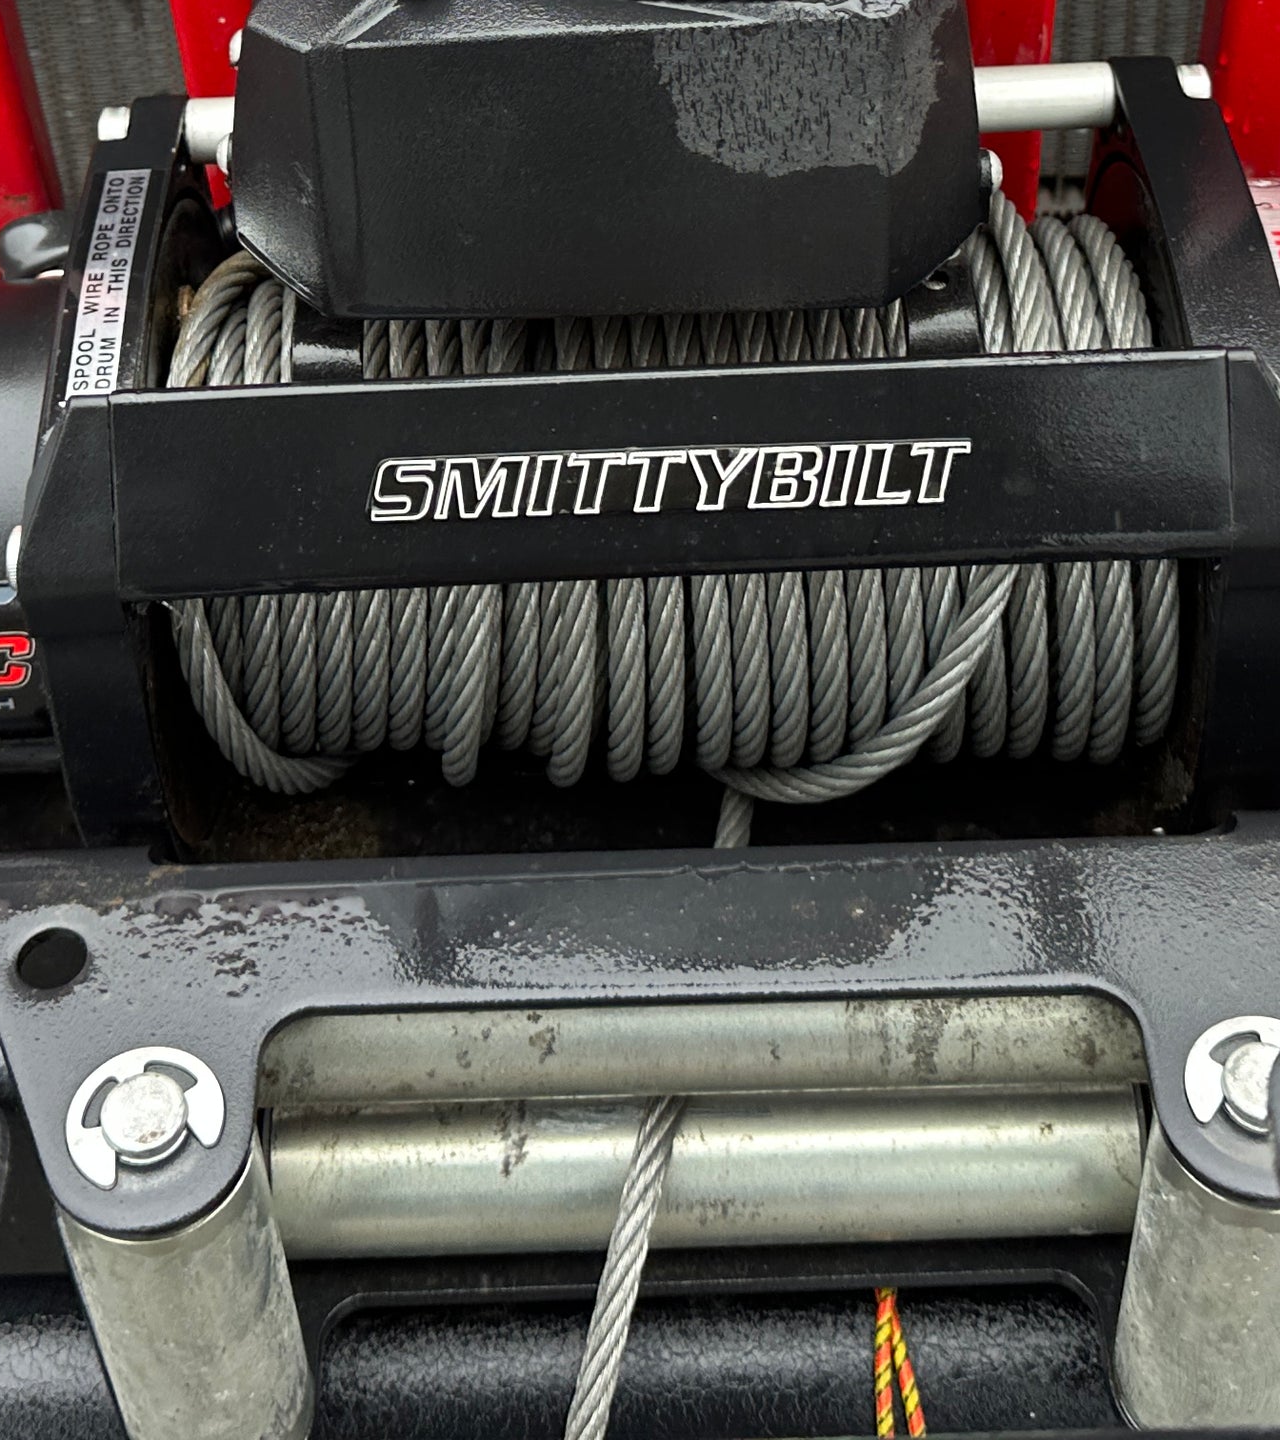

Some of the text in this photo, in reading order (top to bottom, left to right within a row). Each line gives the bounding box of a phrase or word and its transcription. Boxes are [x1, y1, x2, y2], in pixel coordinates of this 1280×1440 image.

[73, 176, 125, 391] SPOOL WIRE ROPE ONTO
[95, 175, 146, 389] DRUM IN THIS DIRECTION
[367, 437, 973, 522] SMITTYBILT
